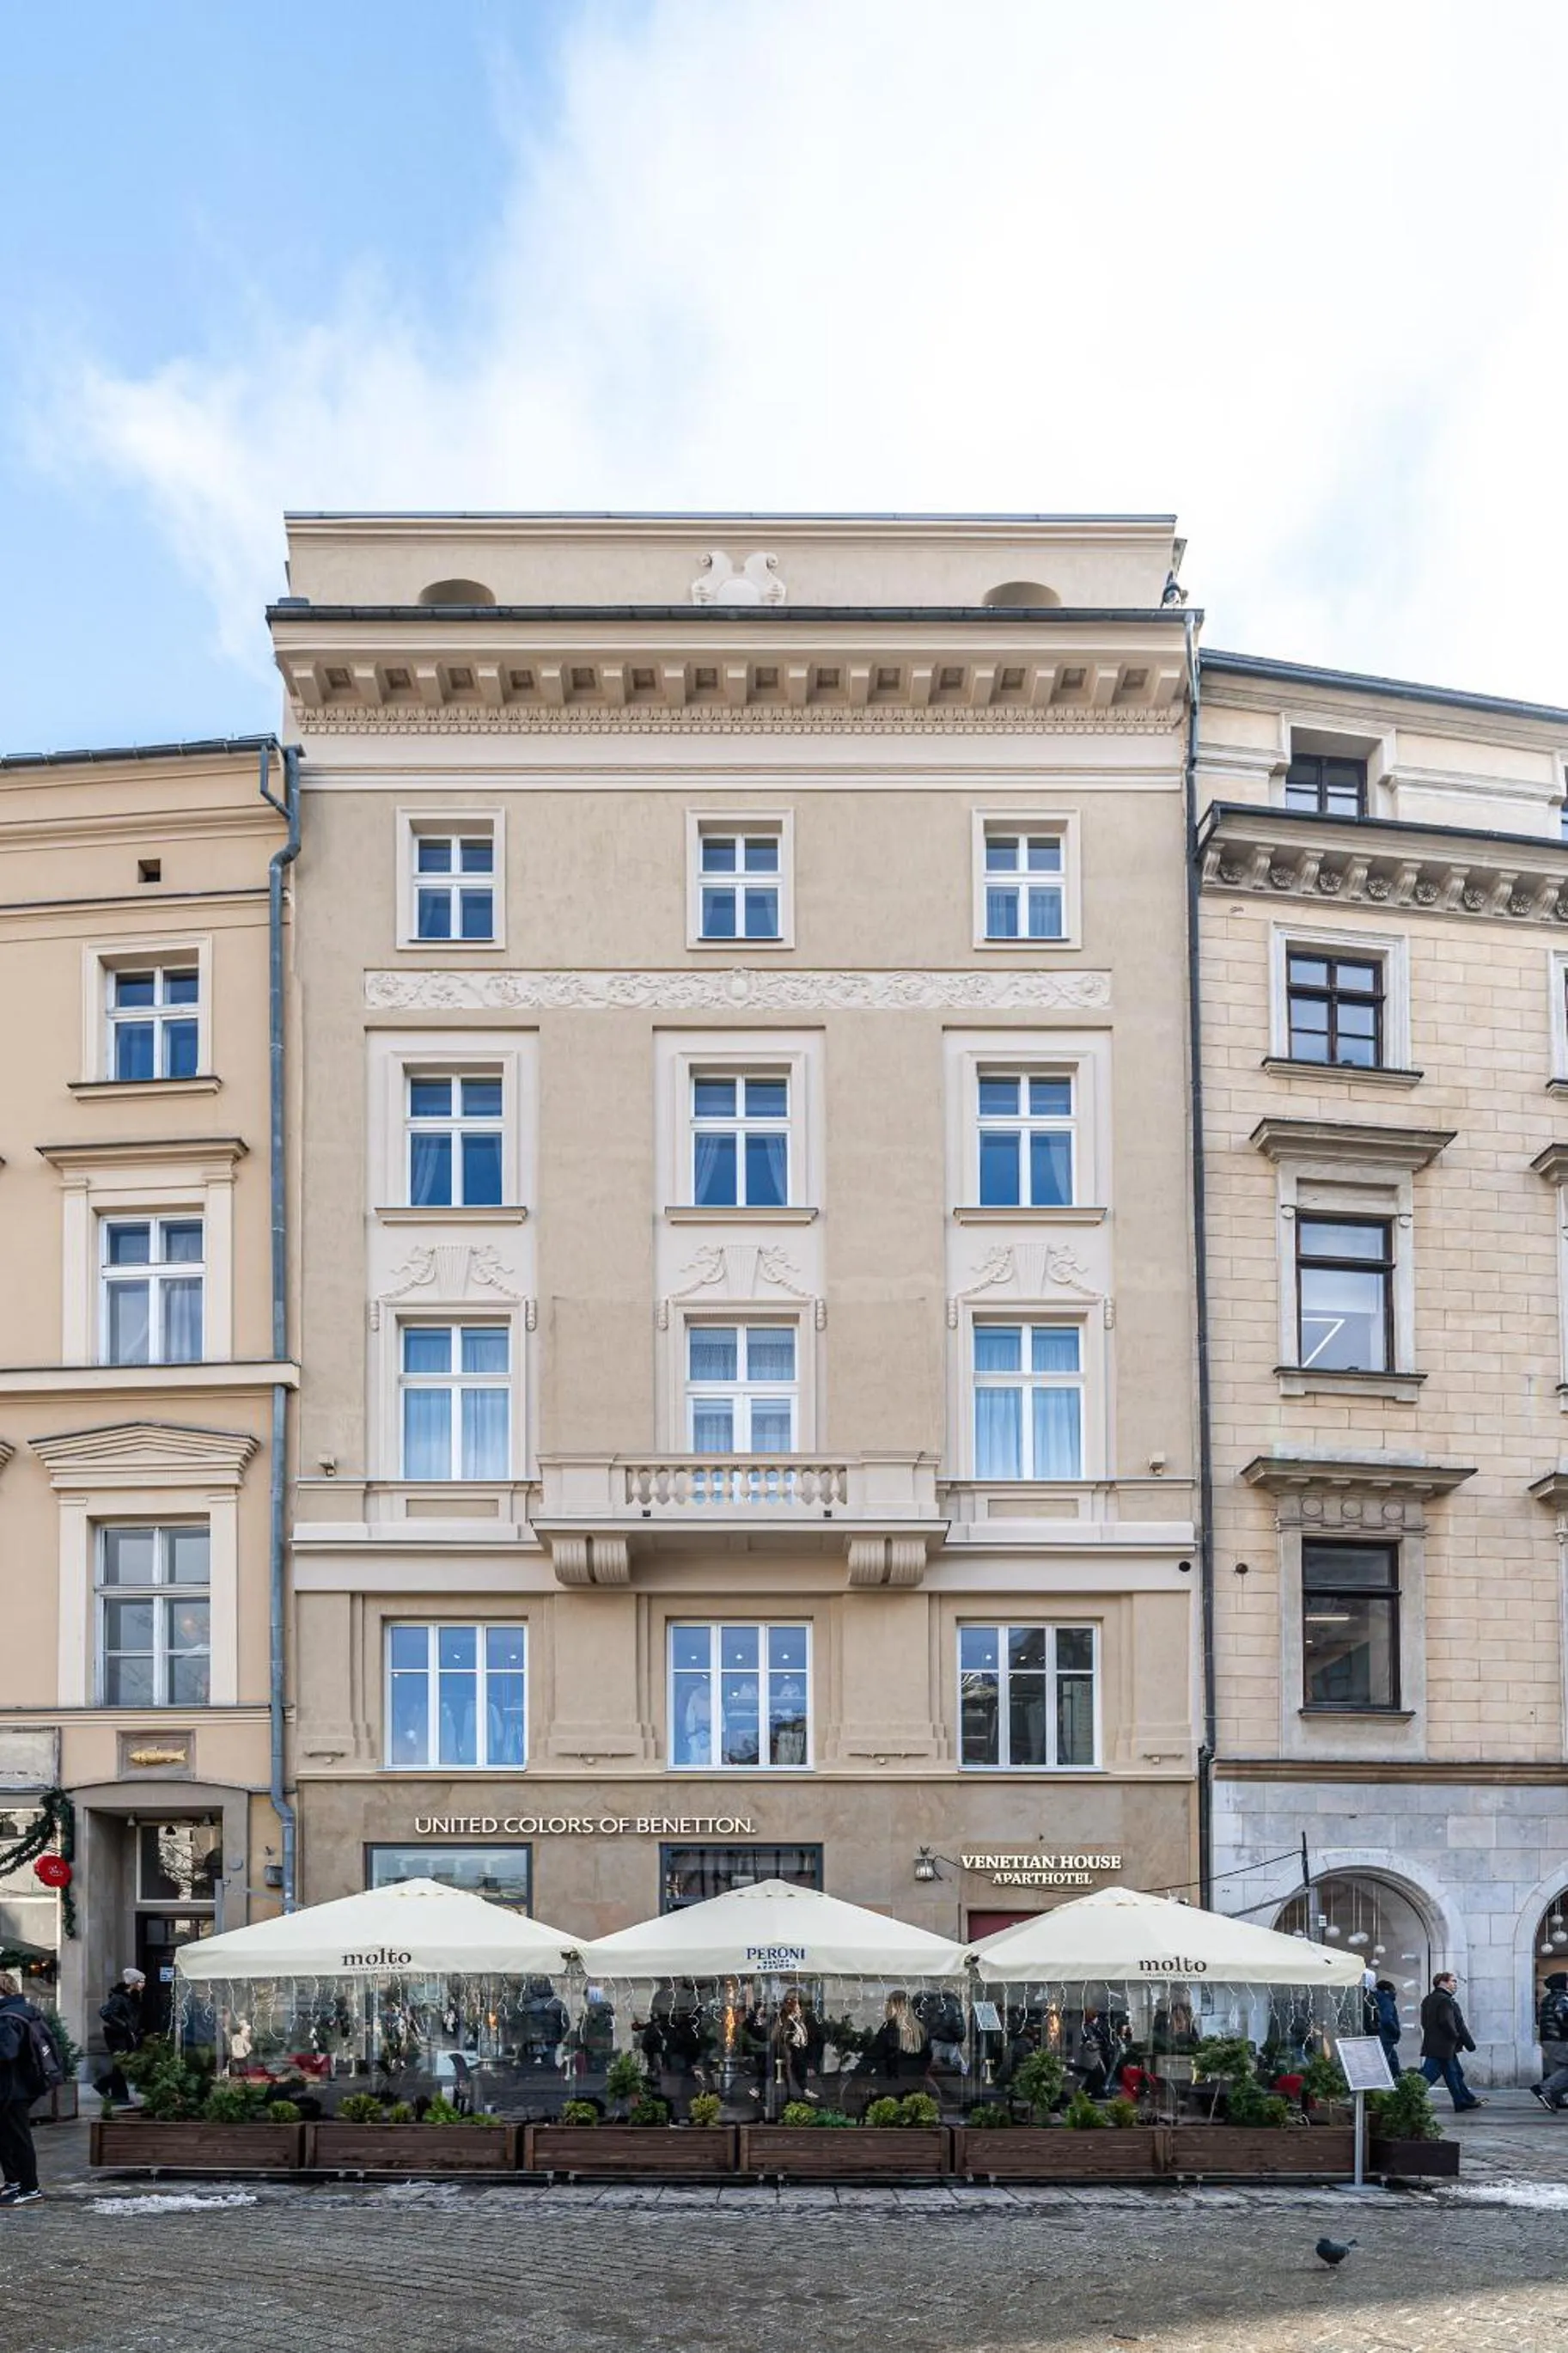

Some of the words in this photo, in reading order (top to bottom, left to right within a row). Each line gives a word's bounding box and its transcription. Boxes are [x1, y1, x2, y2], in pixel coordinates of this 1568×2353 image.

[415, 1817, 498, 1833] UNITED
[504, 1817, 594, 1833] COLORS
[600, 1817, 630, 1833] OF
[637, 1817, 757, 1833] BENETTON.
[961, 1855, 1059, 1869] VENETIAN
[1060, 1855, 1122, 1869] HOUSE
[992, 1872, 1093, 1885] APARTHOTEL
[341, 1947, 412, 1965] molto
[746, 1947, 805, 1960] PERONI
[1138, 1956, 1207, 1972] molto
